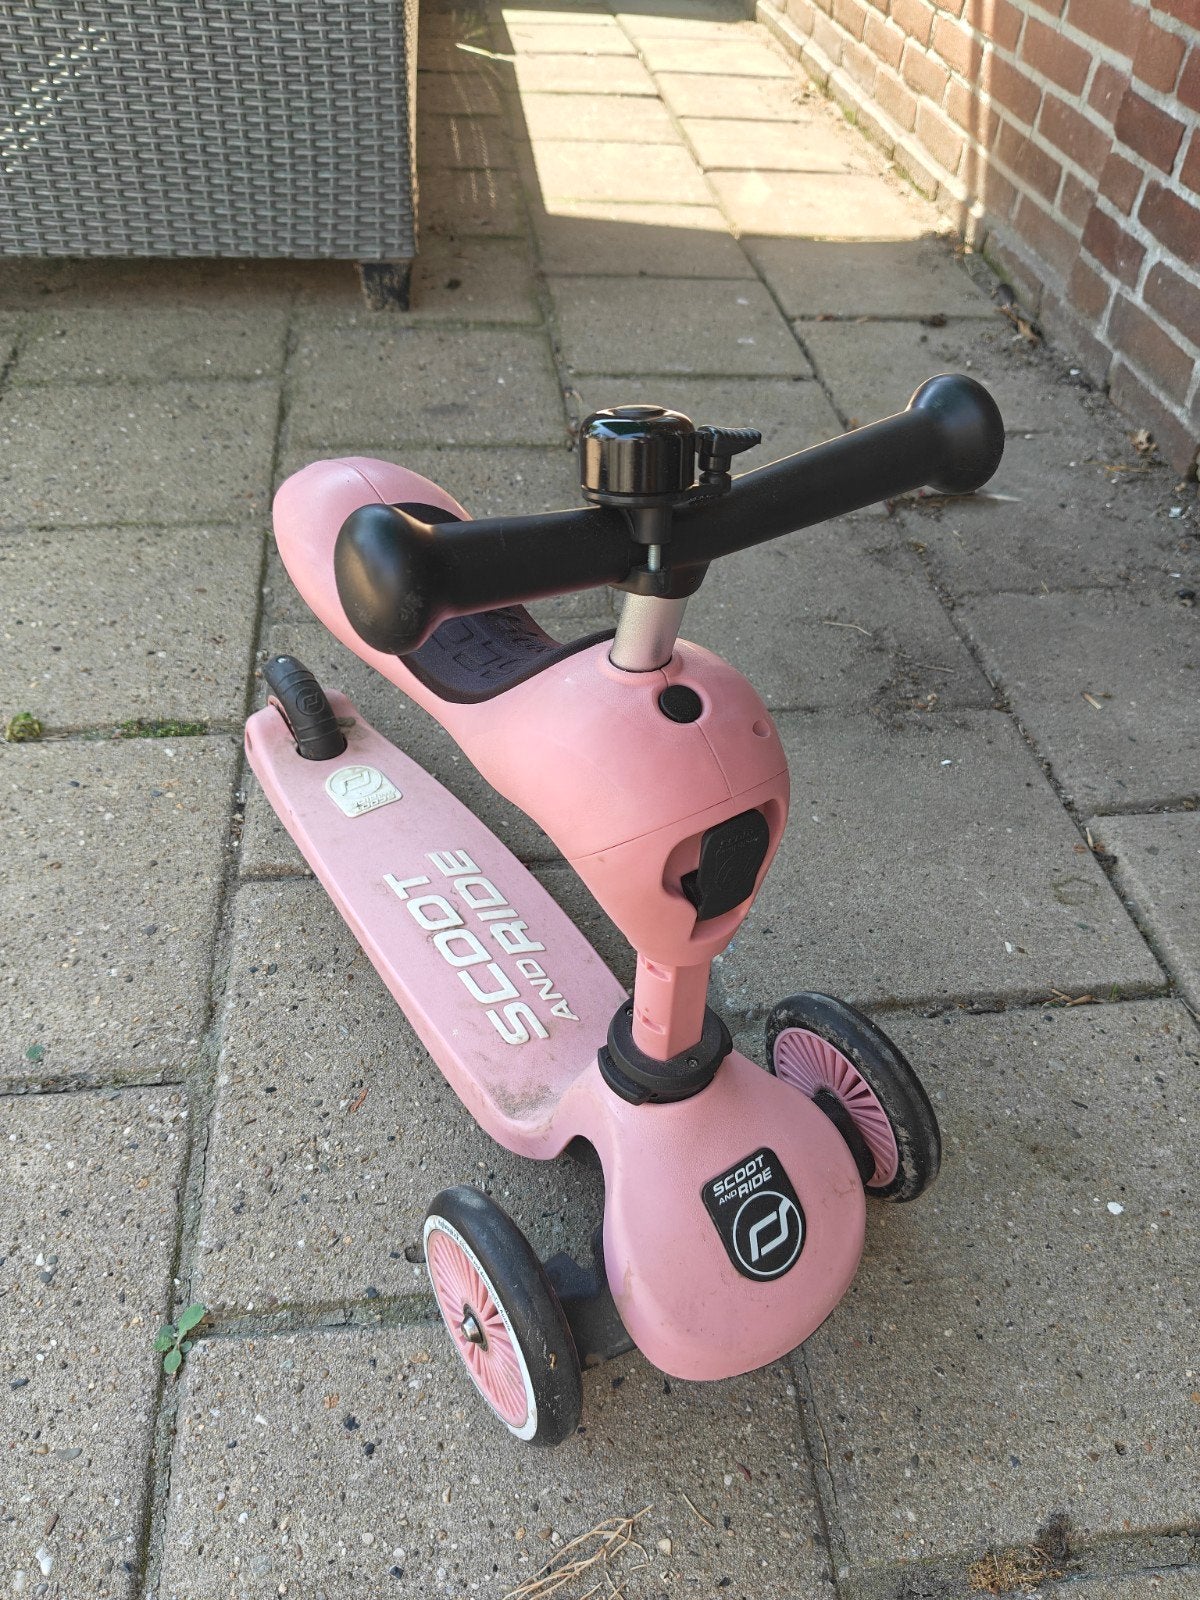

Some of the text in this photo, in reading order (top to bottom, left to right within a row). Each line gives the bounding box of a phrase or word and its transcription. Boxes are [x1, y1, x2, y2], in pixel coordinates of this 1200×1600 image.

[383, 873, 549, 1045] SCOOT
[426, 849, 580, 1021] AND RIDE
[712, 1154, 764, 1197] SCOOT
[719, 1166, 773, 1206] AND RIDE
